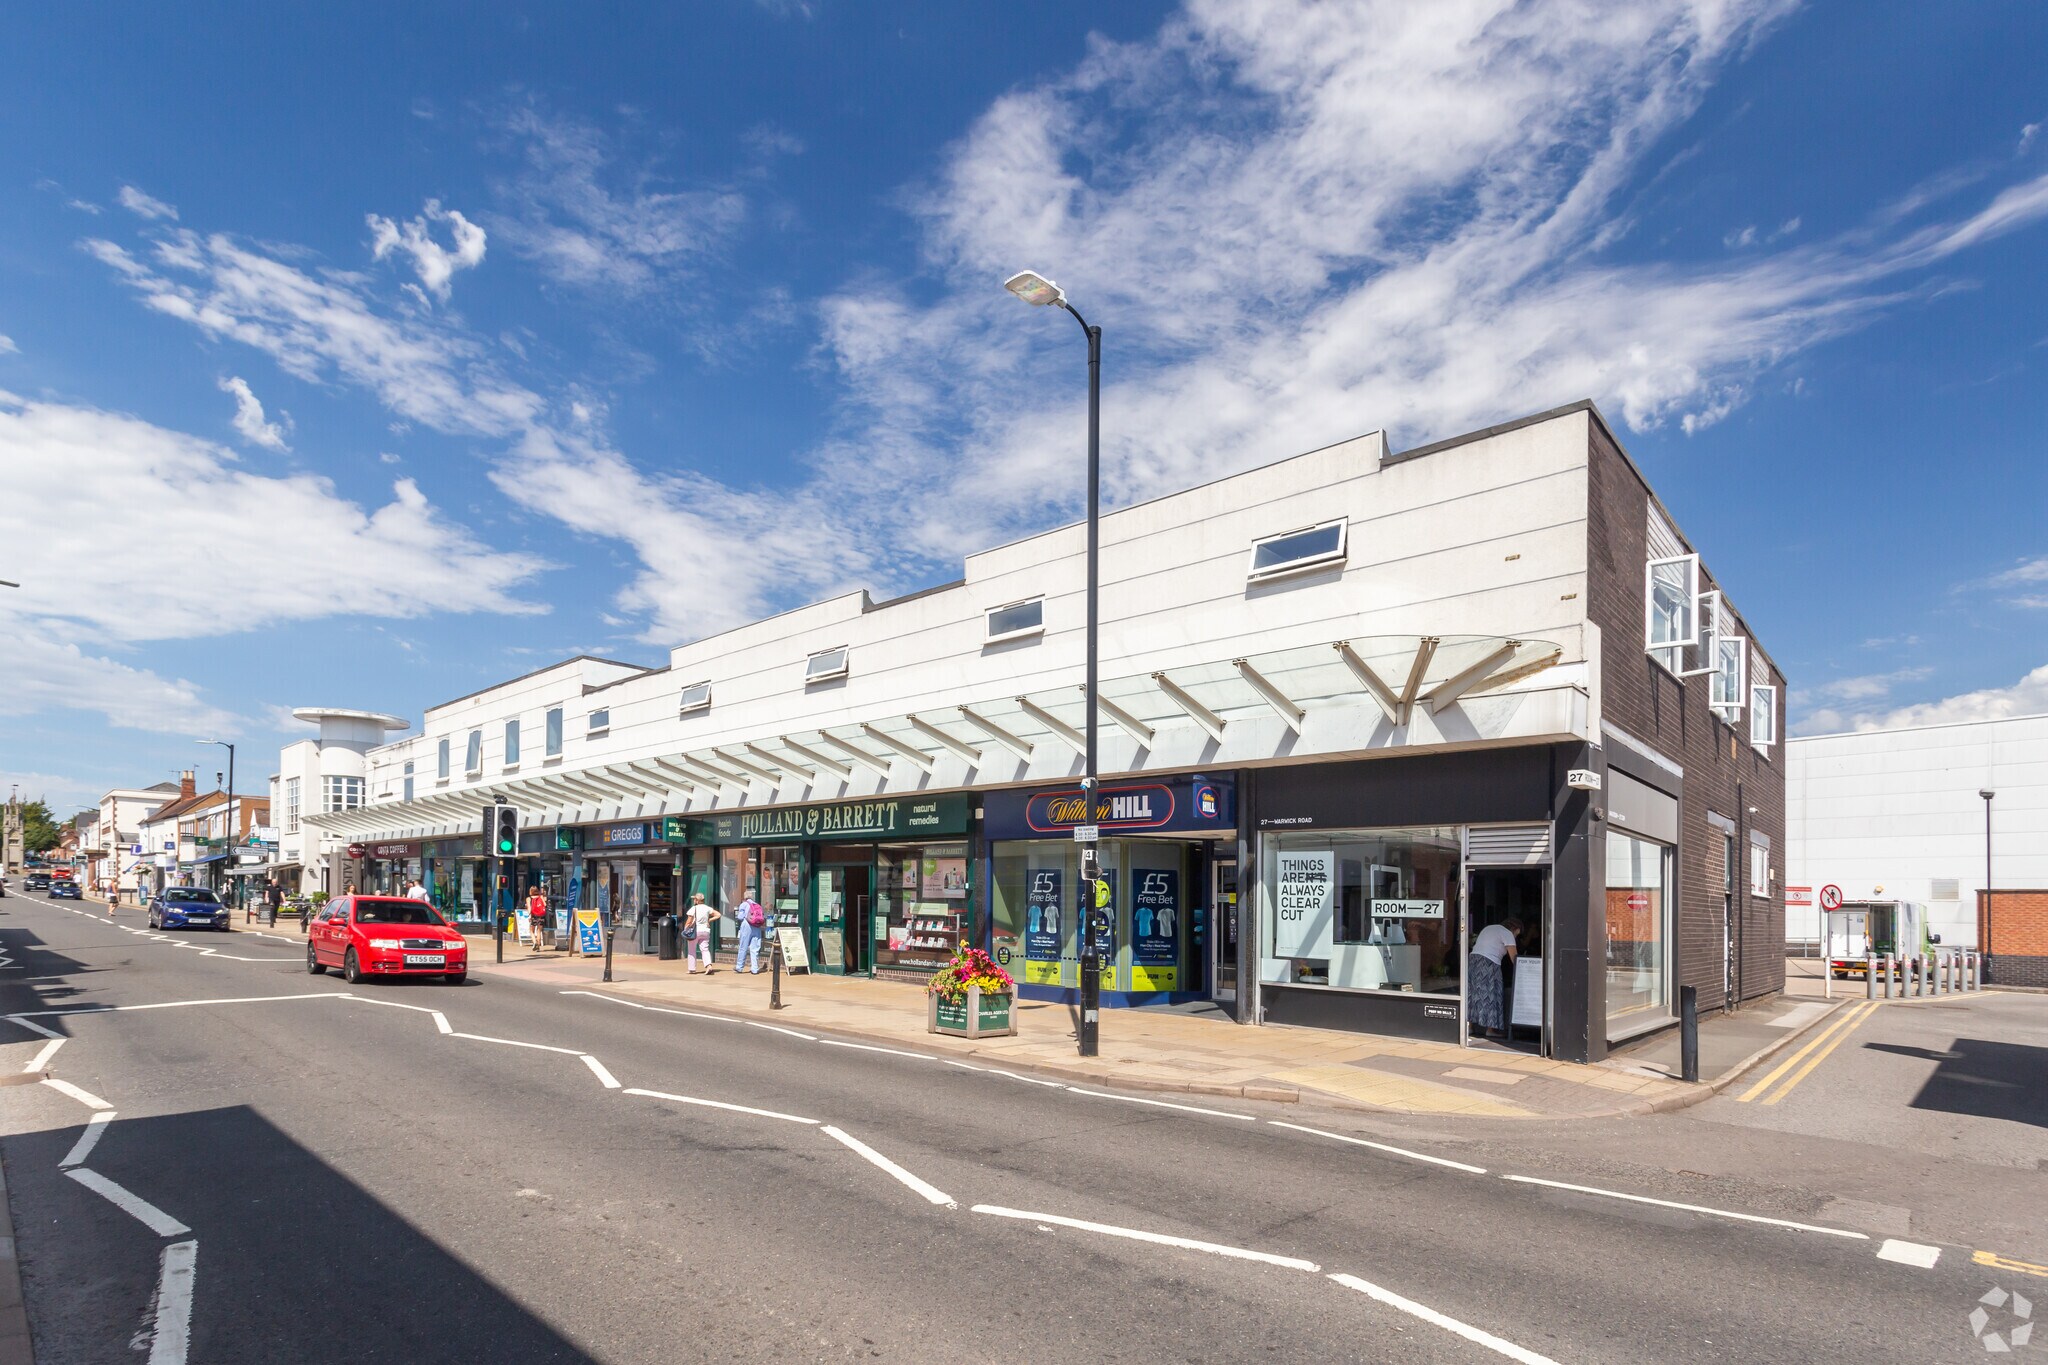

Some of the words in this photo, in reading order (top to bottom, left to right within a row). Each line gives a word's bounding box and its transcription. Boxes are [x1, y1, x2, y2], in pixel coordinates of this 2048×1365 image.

[1570, 773, 1583, 782] 27
[913, 802, 936, 813] natural
[1112, 795, 1152, 819] HILL
[1203, 801, 1215, 813] HILL
[718, 818, 732, 828] health
[741, 810, 803, 839] HOLLAND
[806, 809, 819, 835] &
[822, 802, 898, 830] BARRETT
[909, 815, 939, 826] remedies
[611, 827, 642, 842] GREGGS
[718, 828, 731, 838] foods
[1086, 851, 1091, 859] 4
[1282, 860, 1324, 871] THINGS
[1032, 873, 1054, 893] £5
[1142, 873, 1169, 894] £5
[1281, 885, 1325, 896] ALWAYS
[1029, 893, 1044, 902] Free
[1045, 894, 1058, 902] Bet
[1137, 894, 1156, 904] Free
[1158, 895, 1174, 905] Bet
[1281, 897, 1320, 908] CLEAR
[1281, 909, 1304, 921] CUT
